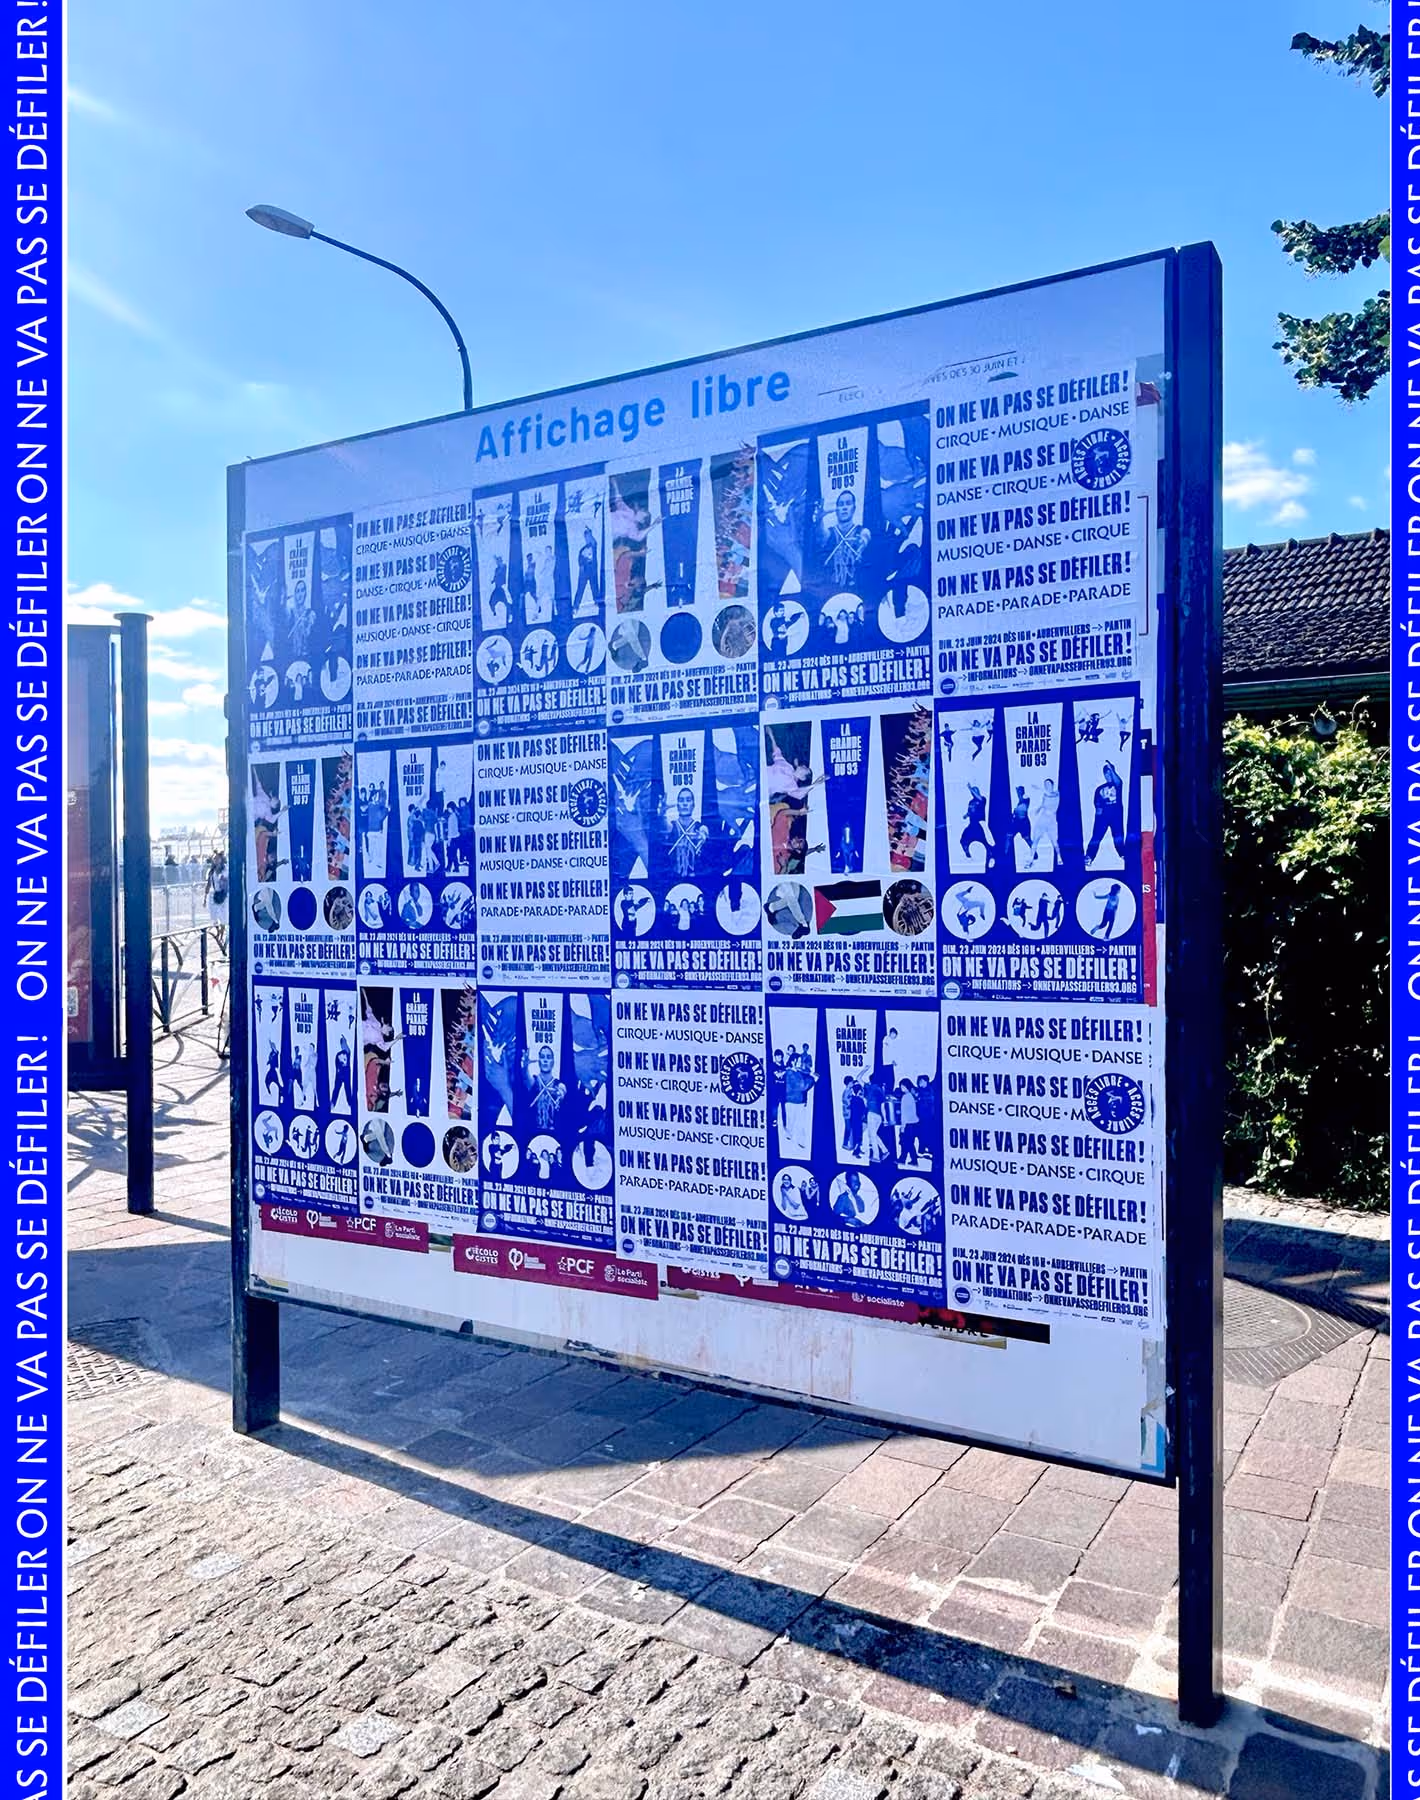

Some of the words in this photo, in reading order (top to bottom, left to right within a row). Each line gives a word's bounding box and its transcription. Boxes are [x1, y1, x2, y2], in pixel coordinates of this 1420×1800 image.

[936, 405, 955, 428] ON
[959, 401, 976, 424] NE
[980, 396, 999, 419] VA
[1003, 390, 1032, 415] PAS
[1036, 385, 1054, 408] SE
[477, 399, 663, 460] Affichage
[692, 372, 789, 417] libre
[610, 686, 625, 704] ON
[628, 684, 641, 703] NE
[645, 683, 659, 701] VA
[662, 680, 683, 700] PAS
[687, 678, 700, 697] SE
[1028, 711, 1038, 724] LA
[840, 723, 850, 736] LA
[1015, 724, 1051, 739] GRANDE
[477, 744, 490, 761] ON
[493, 742, 505, 760] NE
[507, 741, 520, 758] VA
[523, 739, 542, 757] PAS
[545, 737, 557, 755] SE
[830, 735, 861, 749] GRANDE
[1015, 738, 1051, 753] PARADE
[830, 749, 861, 762] PARADE
[1020, 753, 1032, 767] DU
[1034, 752, 1046, 766] 93
[834, 763, 845, 776] DU
[846, 762, 857, 775] 93
[767, 951, 783, 971] ON
[787, 951, 802, 971] NE
[805, 952, 822, 971] VA
[826, 952, 850, 972] PAS
[854, 952, 870, 972] SE
[942, 953, 961, 976] ON
[965, 956, 983, 977] NE
[987, 957, 1006, 977] VA
[1010, 957, 1039, 978] PAS
[1043, 957, 1061, 978] SE
[947, 1015, 966, 1036] ON
[970, 1016, 987, 1037] NE
[992, 1016, 1011, 1037] VA
[1015, 1017, 1044, 1038] PAS
[1048, 1018, 1066, 1039] SE
[618, 1100, 632, 1118] ON
[636, 1101, 649, 1120] NE
[652, 1102, 667, 1121] VA
[670, 1104, 691, 1123] PAS
[694, 1105, 708, 1124] SE
[567, 1257, 594, 1273] PCF
